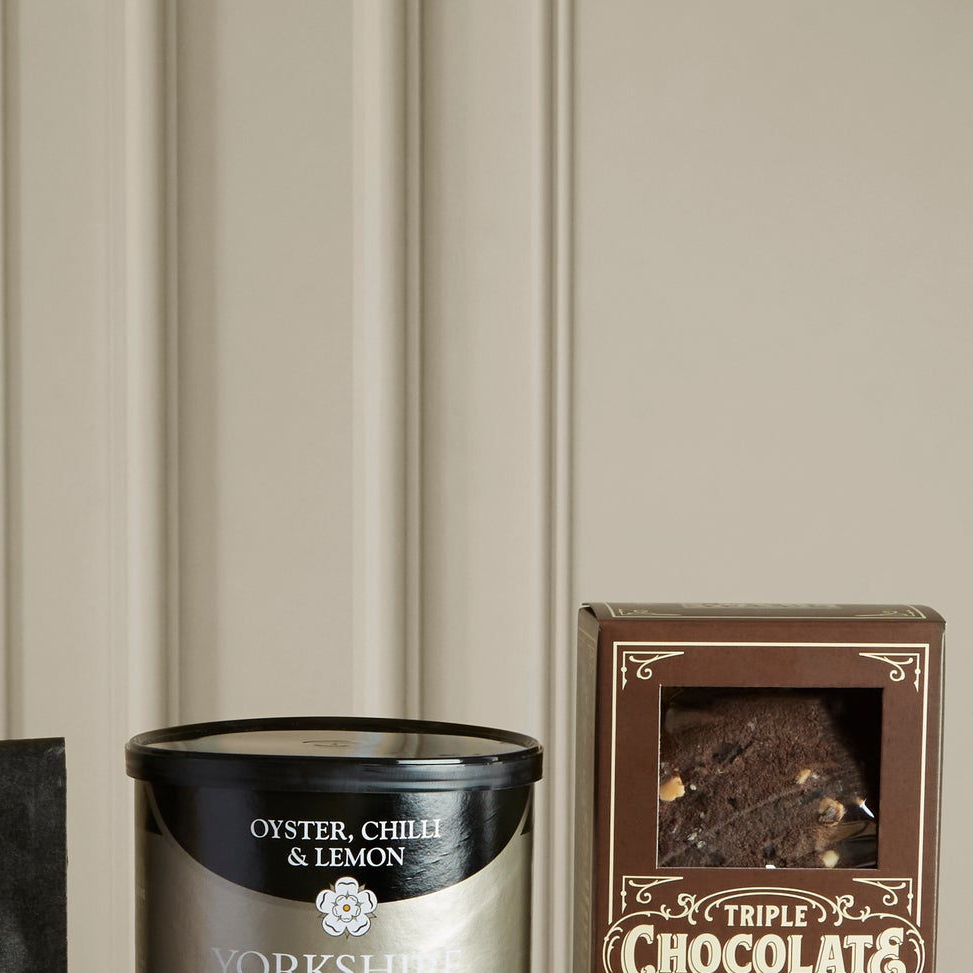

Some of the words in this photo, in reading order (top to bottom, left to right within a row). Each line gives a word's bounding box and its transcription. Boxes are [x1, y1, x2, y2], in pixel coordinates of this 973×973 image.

[250, 818, 355, 843] OYSTER,
[361, 818, 442, 841] CHILLI
[287, 846, 309, 867] &
[315, 846, 406, 868] LEMON
[724, 904, 808, 928] TRIPLE
